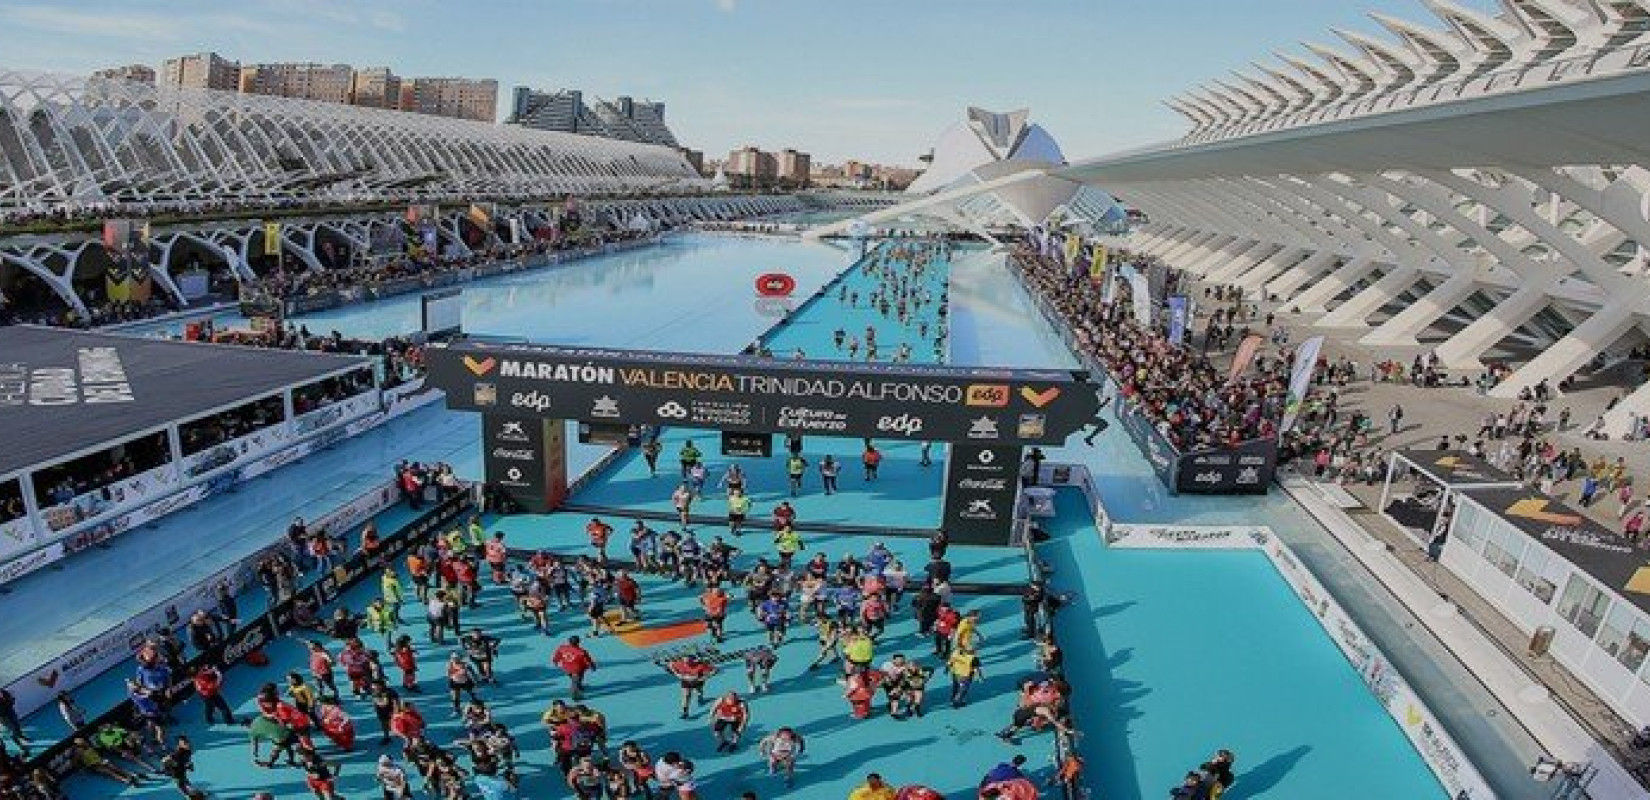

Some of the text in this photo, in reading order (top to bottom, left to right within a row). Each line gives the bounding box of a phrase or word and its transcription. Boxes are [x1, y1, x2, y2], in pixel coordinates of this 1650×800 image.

[500, 359, 1003, 404] MARATÓN VALENCIA TRINIDAD ALFONSO edp
[511, 390, 550, 412] edp
[777, 417, 847, 430] Esfuerzo
[779, 406, 834, 420] Cultura
[877, 413, 923, 435] edp
